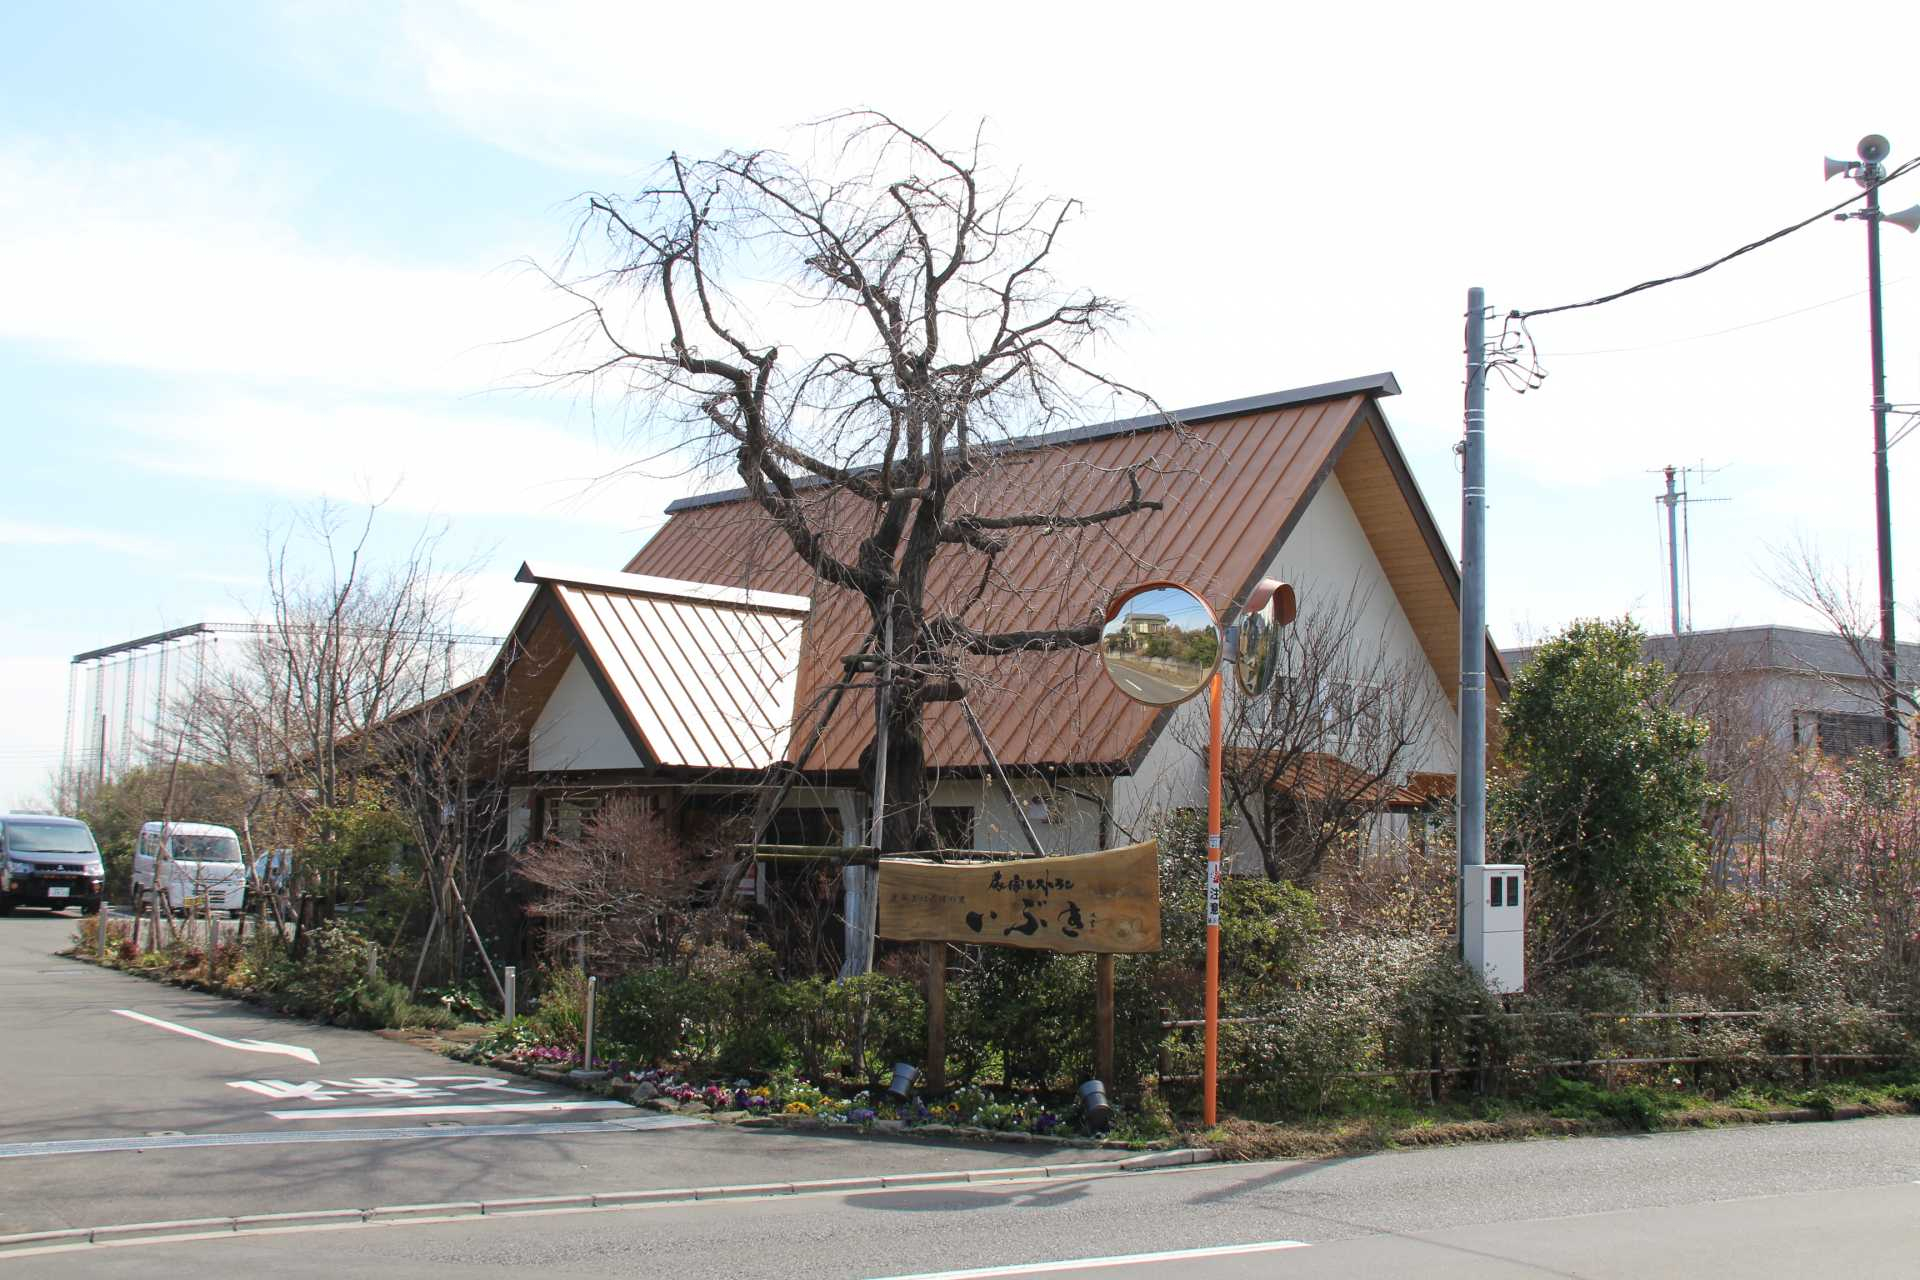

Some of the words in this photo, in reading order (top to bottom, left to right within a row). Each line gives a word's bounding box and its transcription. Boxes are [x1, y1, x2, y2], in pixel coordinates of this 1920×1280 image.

[966, 898, 1085, 938] いぶき
[1210, 888, 1219, 915] 注意
